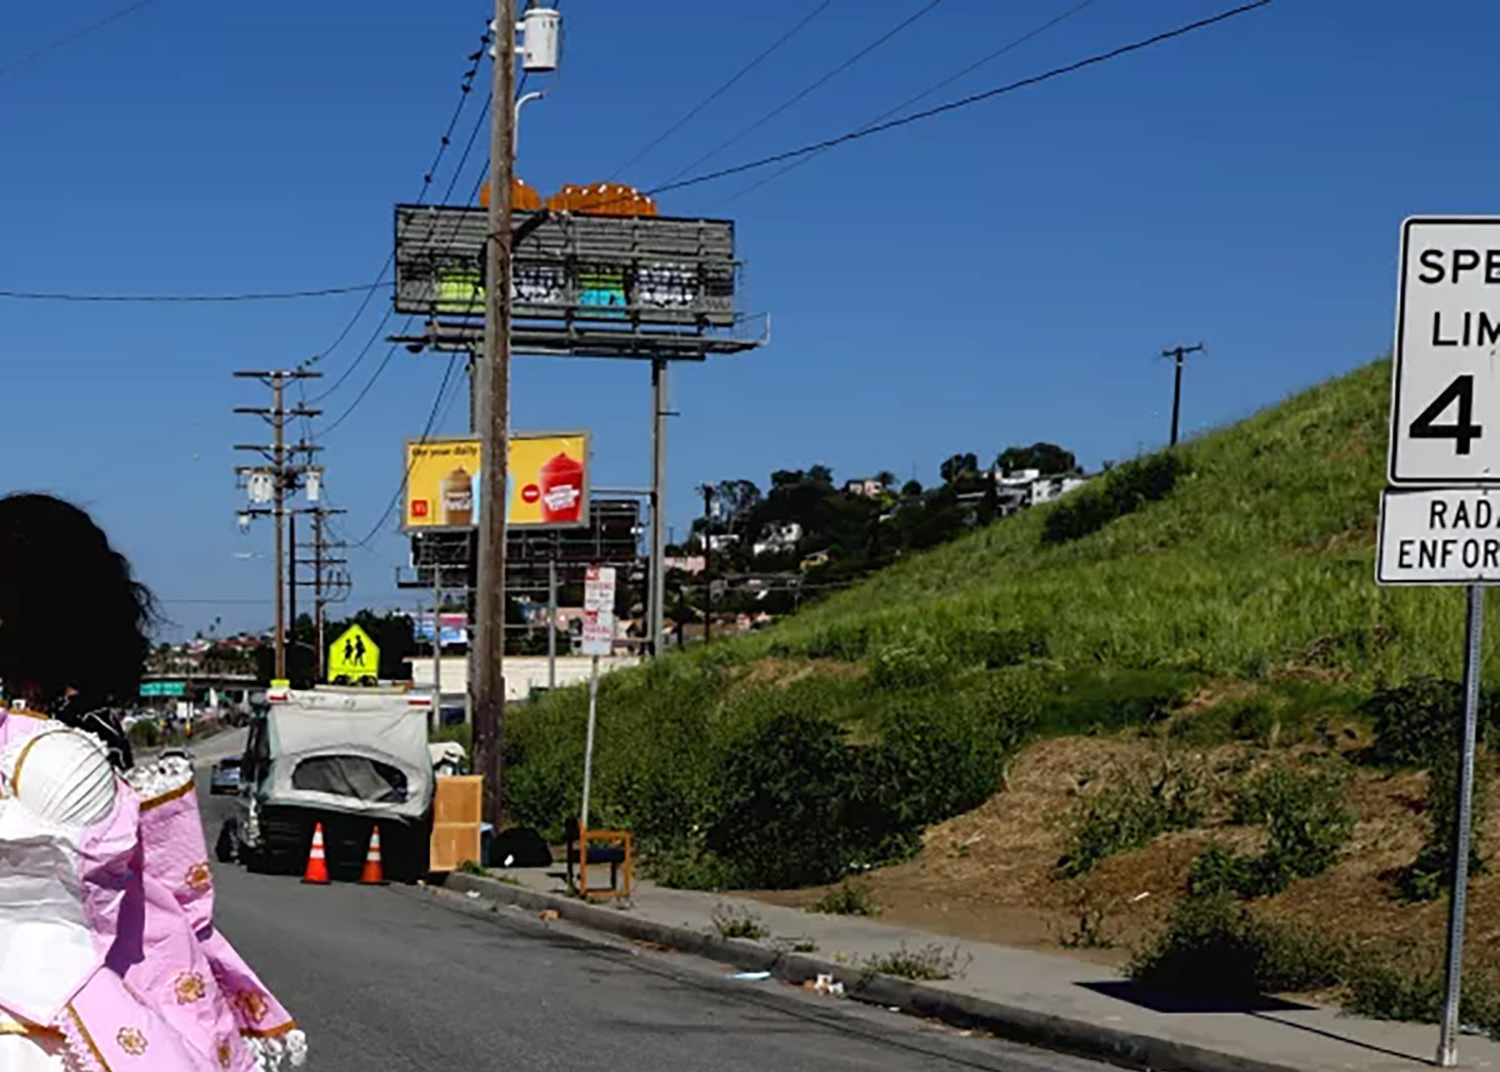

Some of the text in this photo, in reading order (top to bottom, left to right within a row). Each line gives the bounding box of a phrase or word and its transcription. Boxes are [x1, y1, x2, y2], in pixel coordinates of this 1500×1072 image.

[1419, 249, 1500, 284] SPE
[1432, 311, 1500, 346] LIM
[1409, 374, 1482, 455] 4
[1430, 499, 1500, 529] RAD
[1398, 539, 1500, 568] ENFOR
